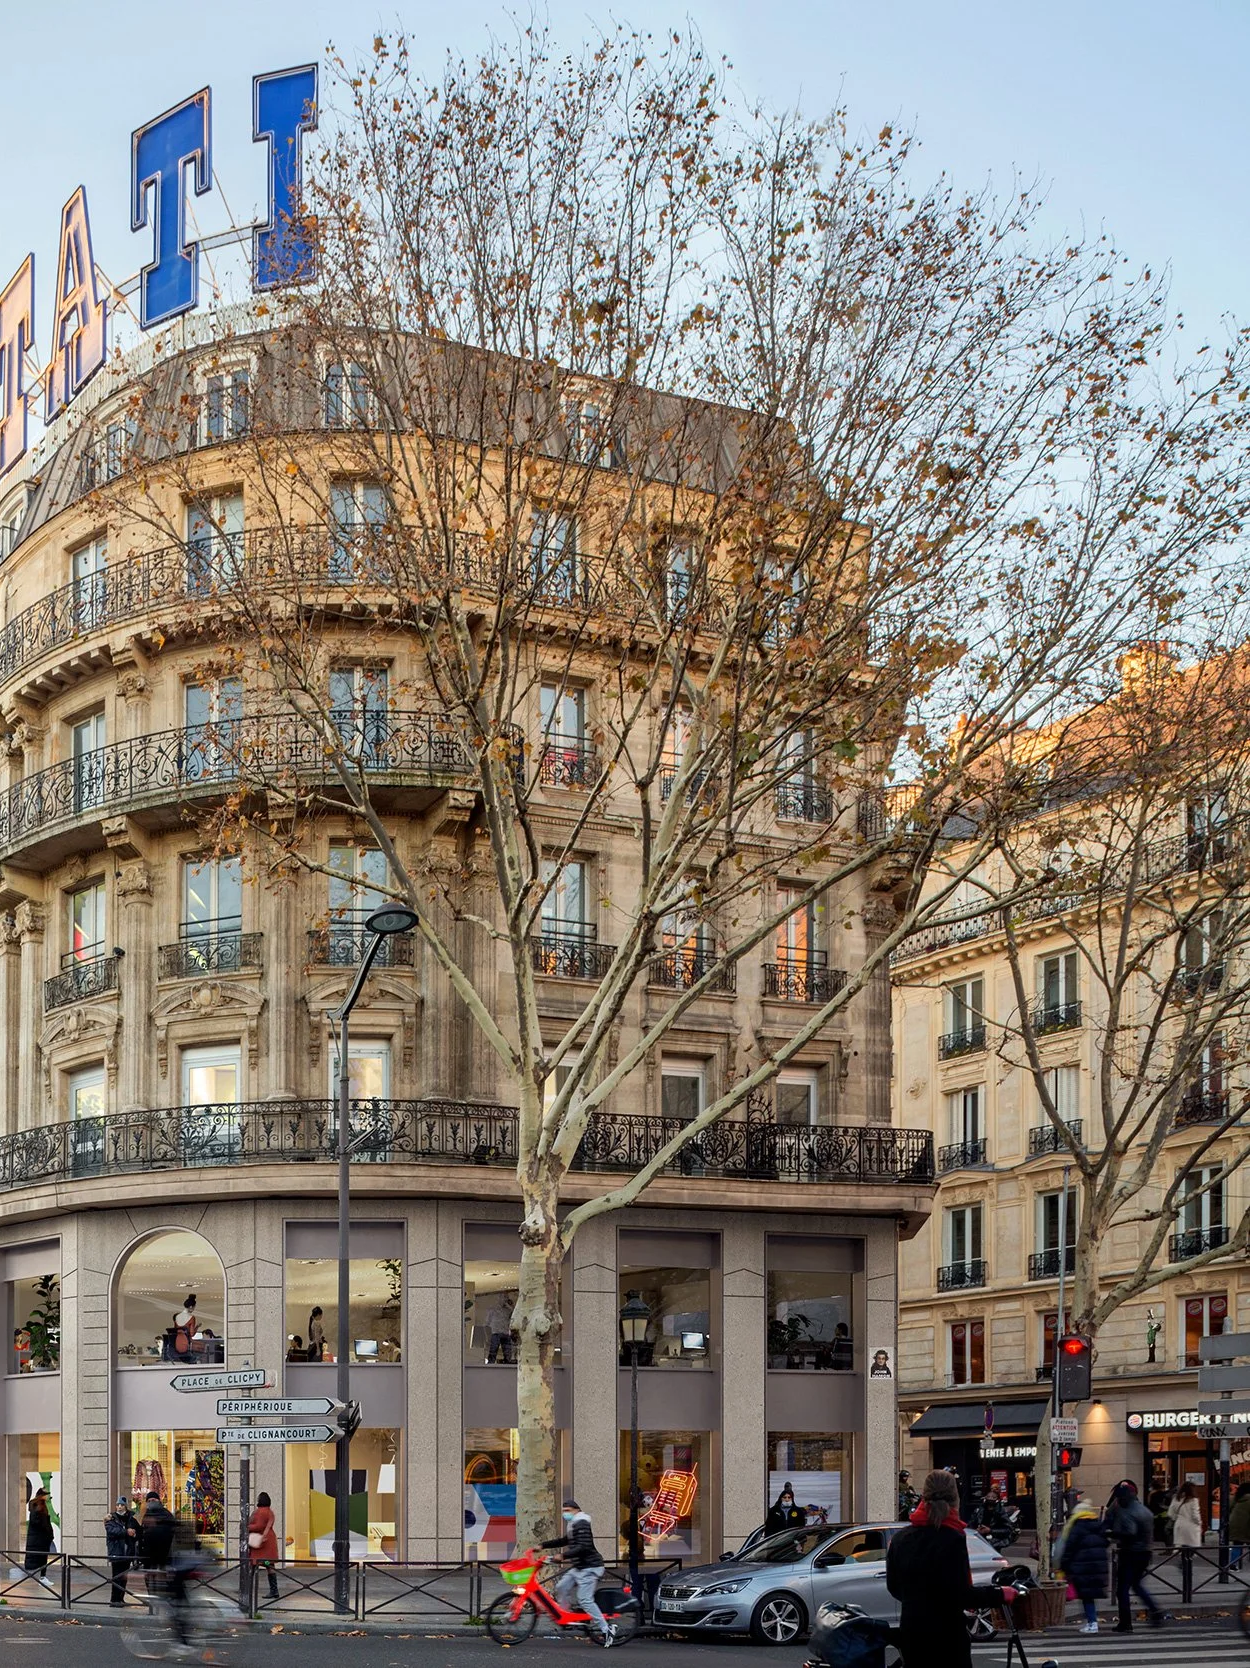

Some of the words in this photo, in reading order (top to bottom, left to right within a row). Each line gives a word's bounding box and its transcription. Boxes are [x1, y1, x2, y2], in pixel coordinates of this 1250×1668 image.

[181, 1377, 209, 1387] PLACE
[227, 1373, 261, 1384] CLICHY
[221, 1401, 293, 1411] PÉRIPHÉRIQUE
[247, 1429, 317, 1439] CLIGNANCOURT
[980, 1448, 1005, 1458] VENTE
